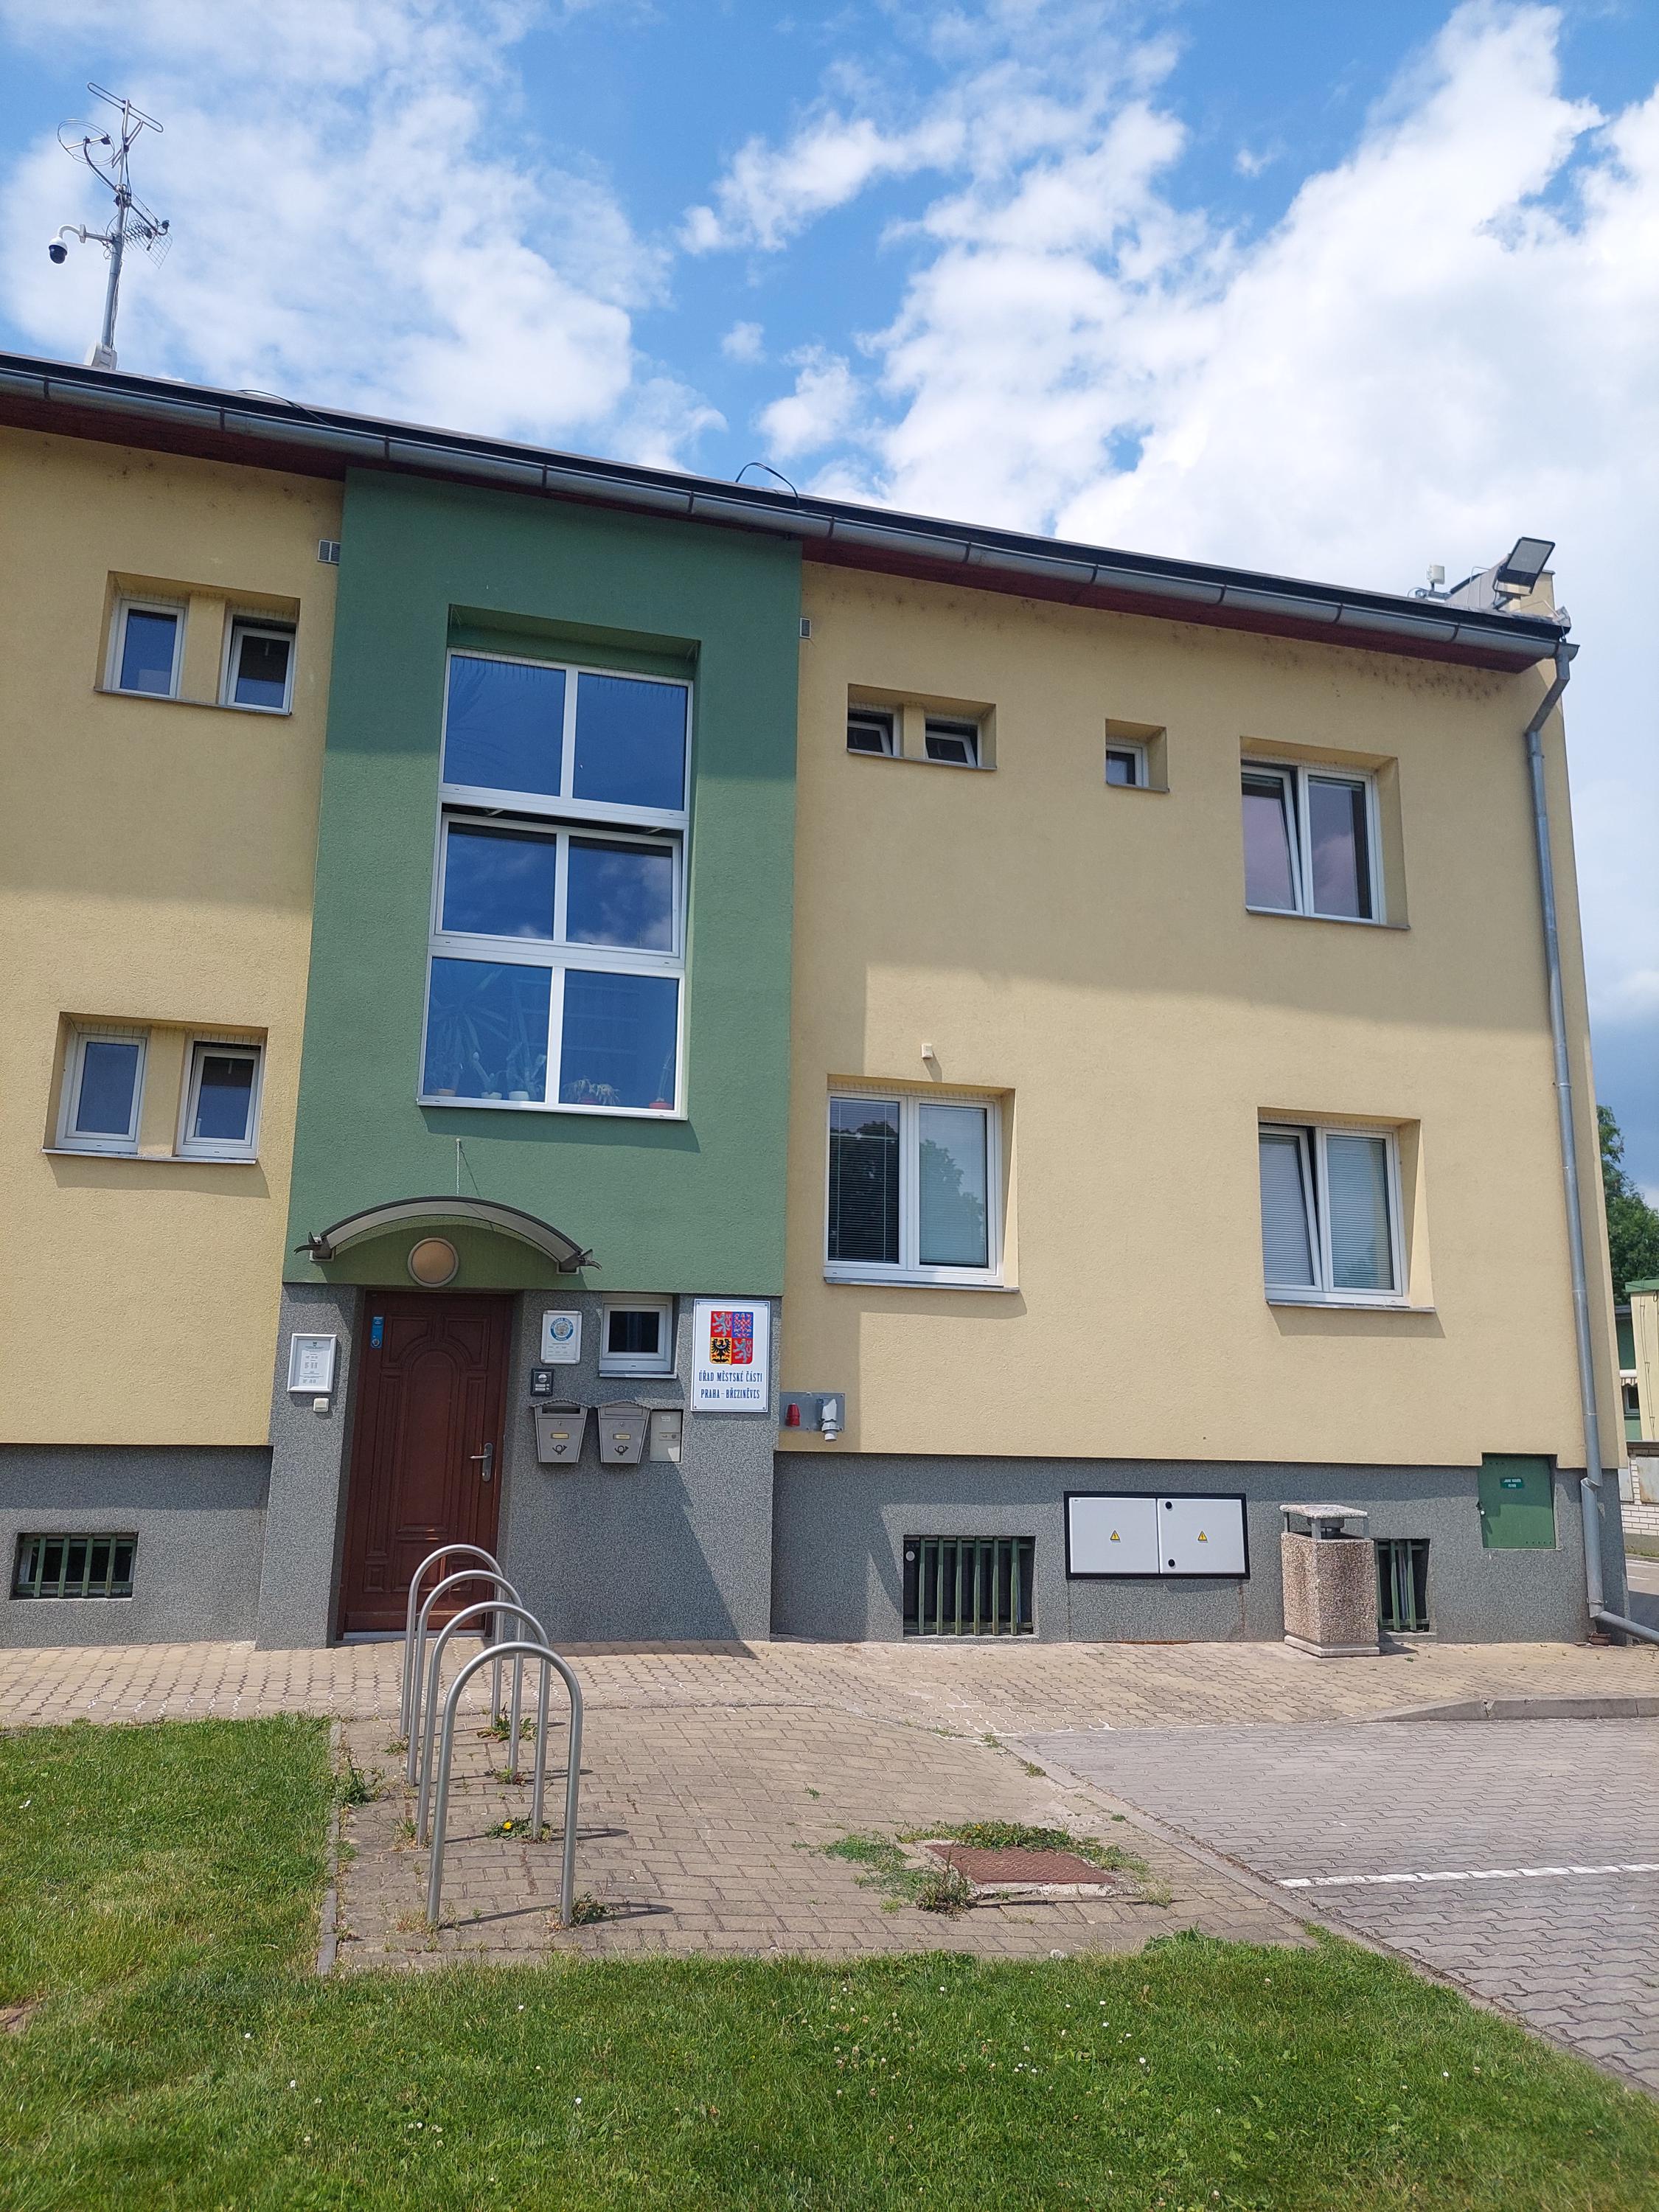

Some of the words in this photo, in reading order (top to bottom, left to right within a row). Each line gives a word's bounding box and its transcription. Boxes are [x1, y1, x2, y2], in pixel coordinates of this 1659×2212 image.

[698, 1370, 714, 1382] ÚŘAD
[717, 1370, 743, 1382] MĚSTSKÉ
[745, 1371, 762, 1382] ČÁSTI
[700, 1388, 720, 1398] PRAHA
[726, 1387, 760, 1399] BŘEZINĚVES
